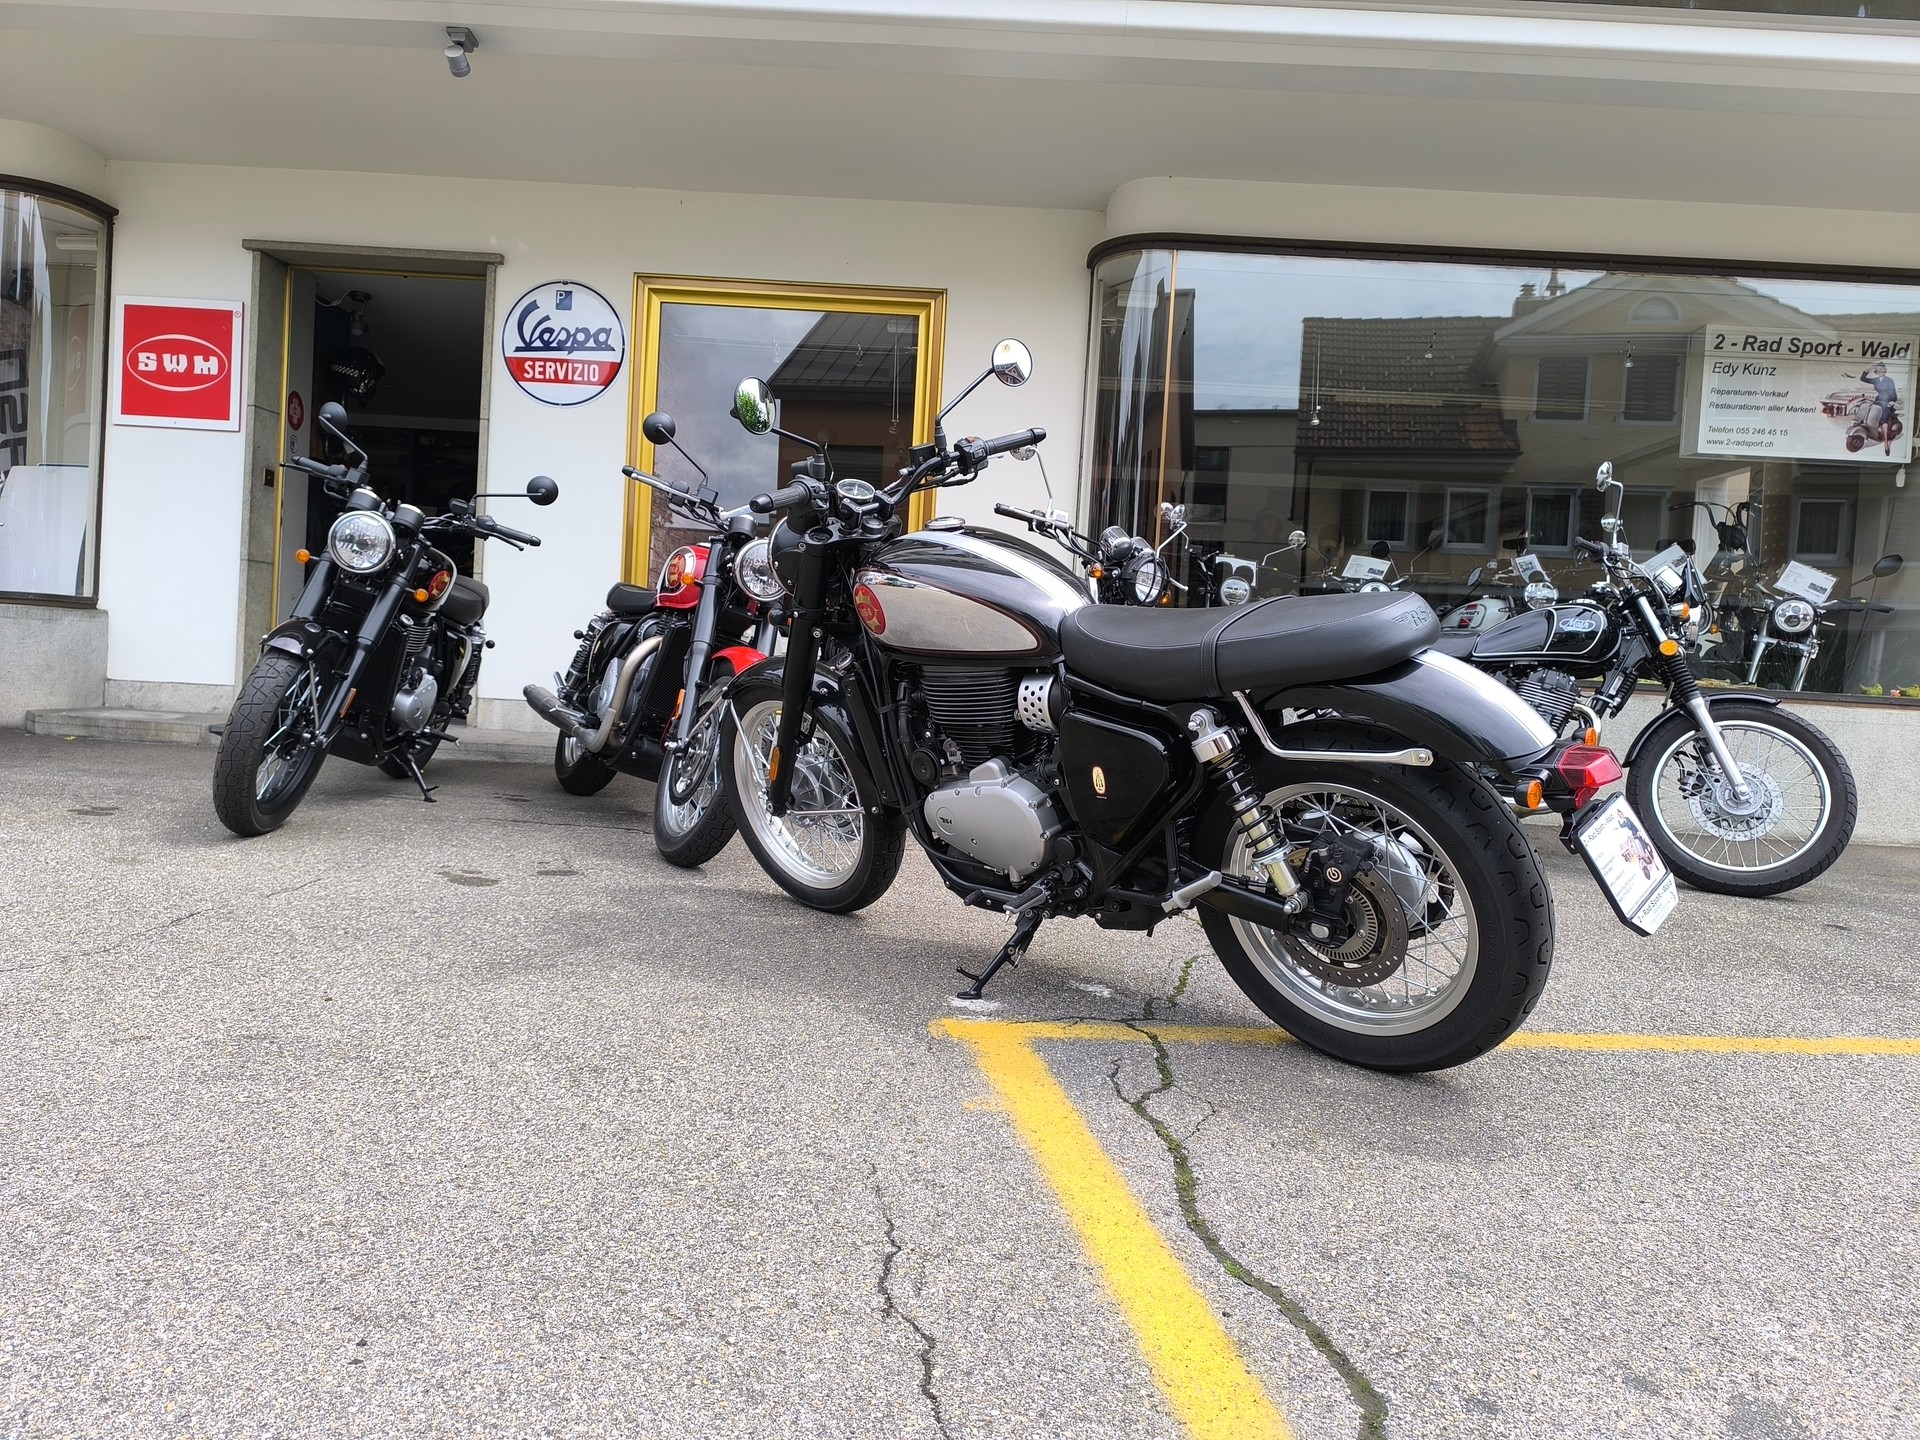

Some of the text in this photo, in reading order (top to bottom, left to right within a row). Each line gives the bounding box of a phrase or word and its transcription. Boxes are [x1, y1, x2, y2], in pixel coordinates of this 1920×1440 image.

[514, 299, 615, 355] Vespa
[1713, 333, 1726, 350] 2
[1741, 334, 1783, 353] Rad
[1787, 337, 1843, 358] Sport
[1861, 340, 1911, 359] Wald
[137, 352, 219, 375] SWM
[523, 360, 600, 382] SERVIZIO
[1712, 361, 1777, 378] Edy Kunz
[1710, 387, 1790, 399] Reparaturen-Verkauf
[1708, 401, 1817, 414] Restaurationen aller Marken!
[1707, 425, 1789, 437] Telefon 055 246 45 15
[1706, 438, 1774, 449] www.2-radsport.ch
